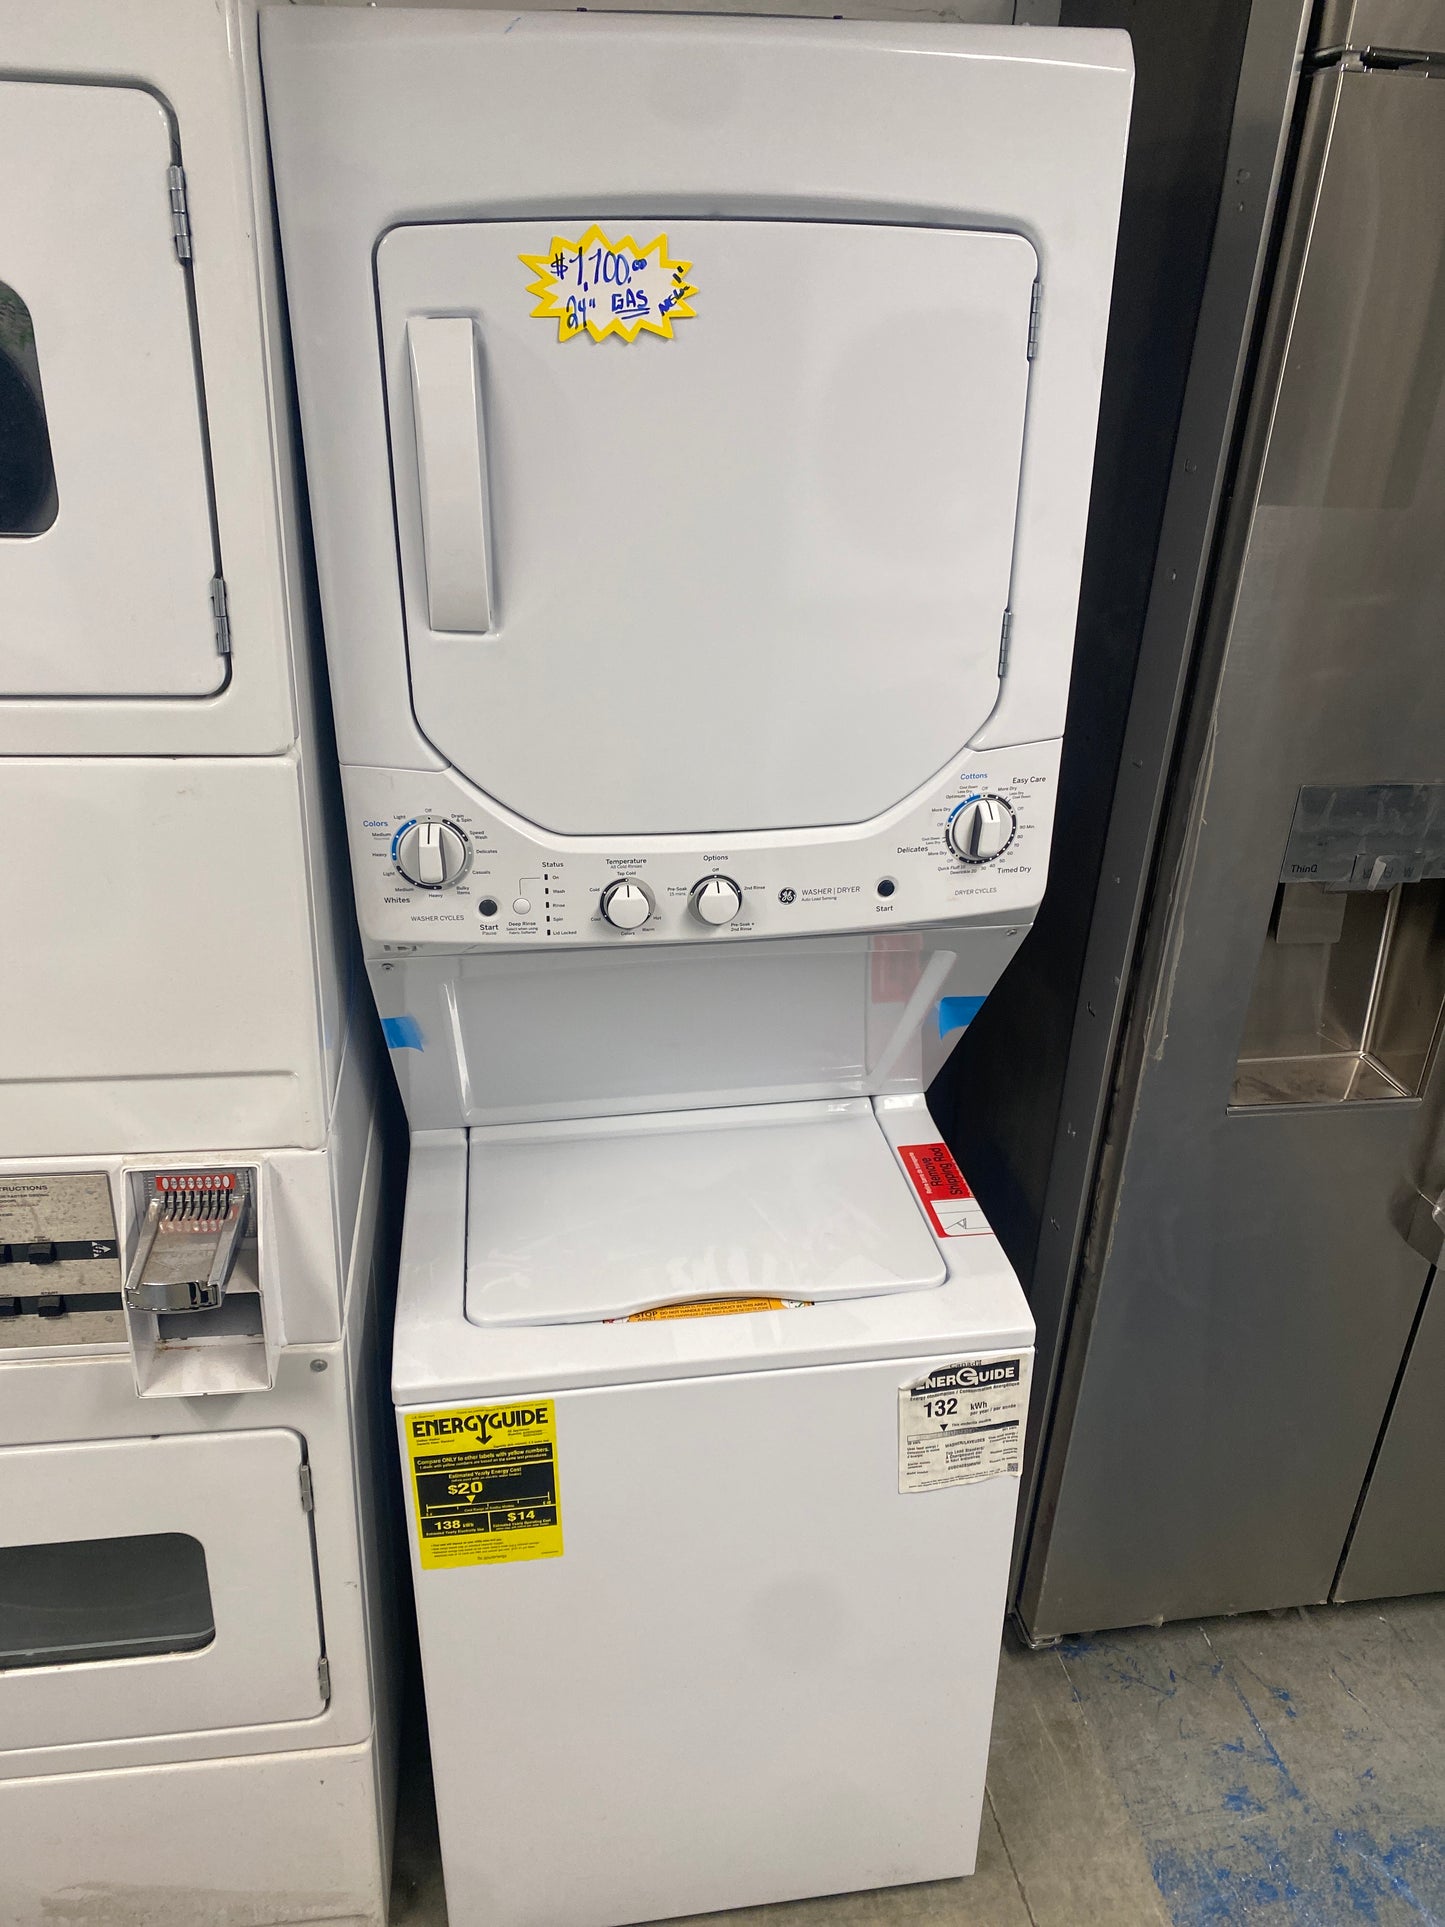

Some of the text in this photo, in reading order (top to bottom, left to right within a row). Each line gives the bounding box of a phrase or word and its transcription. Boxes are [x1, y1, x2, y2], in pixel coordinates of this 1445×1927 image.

[611, 288, 648, 312] GAS
[363, 820, 389, 828] Colors
[1291, 864, 1318, 873] ThinQ
[802, 886, 861, 896] WASHER DRYER
[928, 1147, 946, 1162] Rod
[922, 1157, 944, 1187] Remove
[941, 1163, 963, 1195] Shipping
[924, 1398, 958, 1418] 132
[970, 1401, 987, 1410] kWh
[412, 1407, 548, 1440] ENERGYGUIDE
[417, 1458, 441, 1466] Compare
[479, 1452, 495, 1460] labels
[508, 1449, 524, 1457] yellow
[448, 1472, 474, 1480] Estimated
[474, 1470, 490, 1478] Yearly
[491, 1468, 509, 1476] Energy
[448, 1481, 483, 1496] $20
[507, 1510, 535, 1522] $14
[434, 1520, 461, 1530] 138
